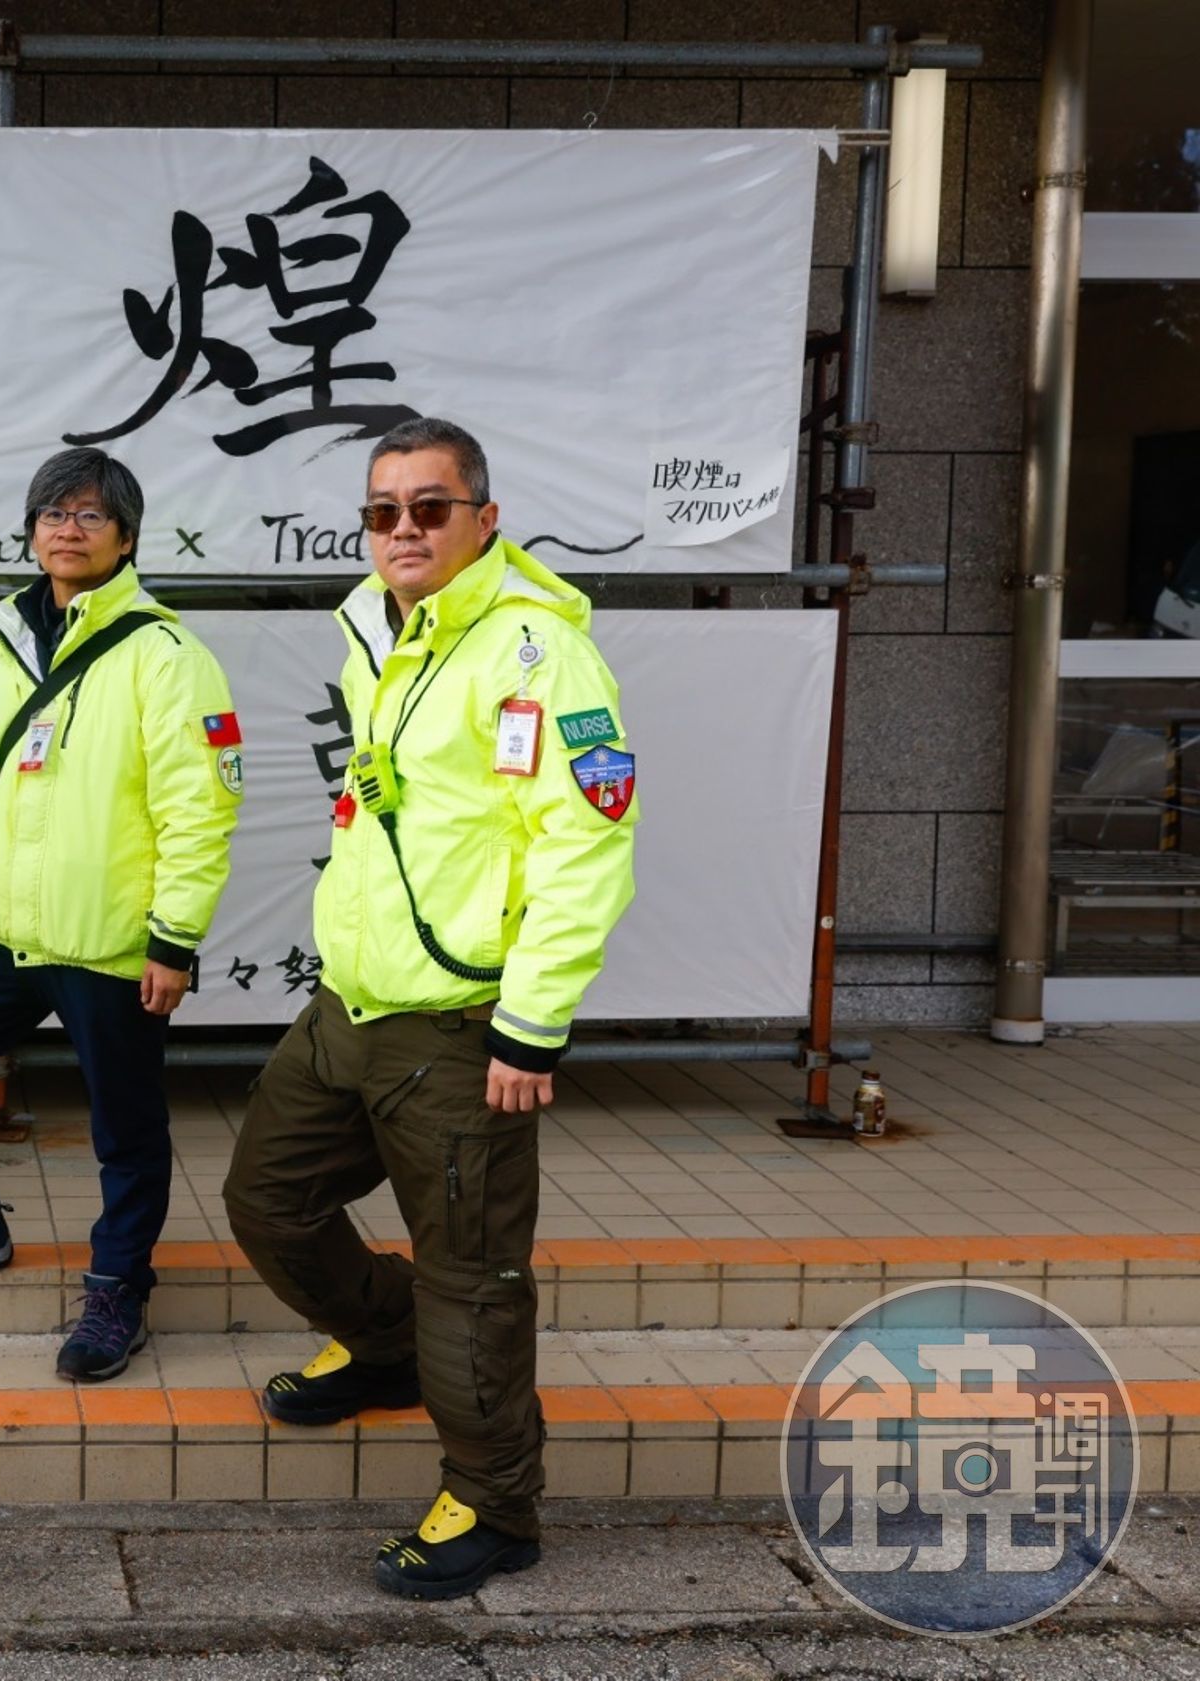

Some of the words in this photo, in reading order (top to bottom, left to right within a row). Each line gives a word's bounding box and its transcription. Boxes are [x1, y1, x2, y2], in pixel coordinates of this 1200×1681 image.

[652, 457, 741, 491] 喫煙は
[261, 512, 365, 564] Trad
[562, 713, 613, 742] NURSE
